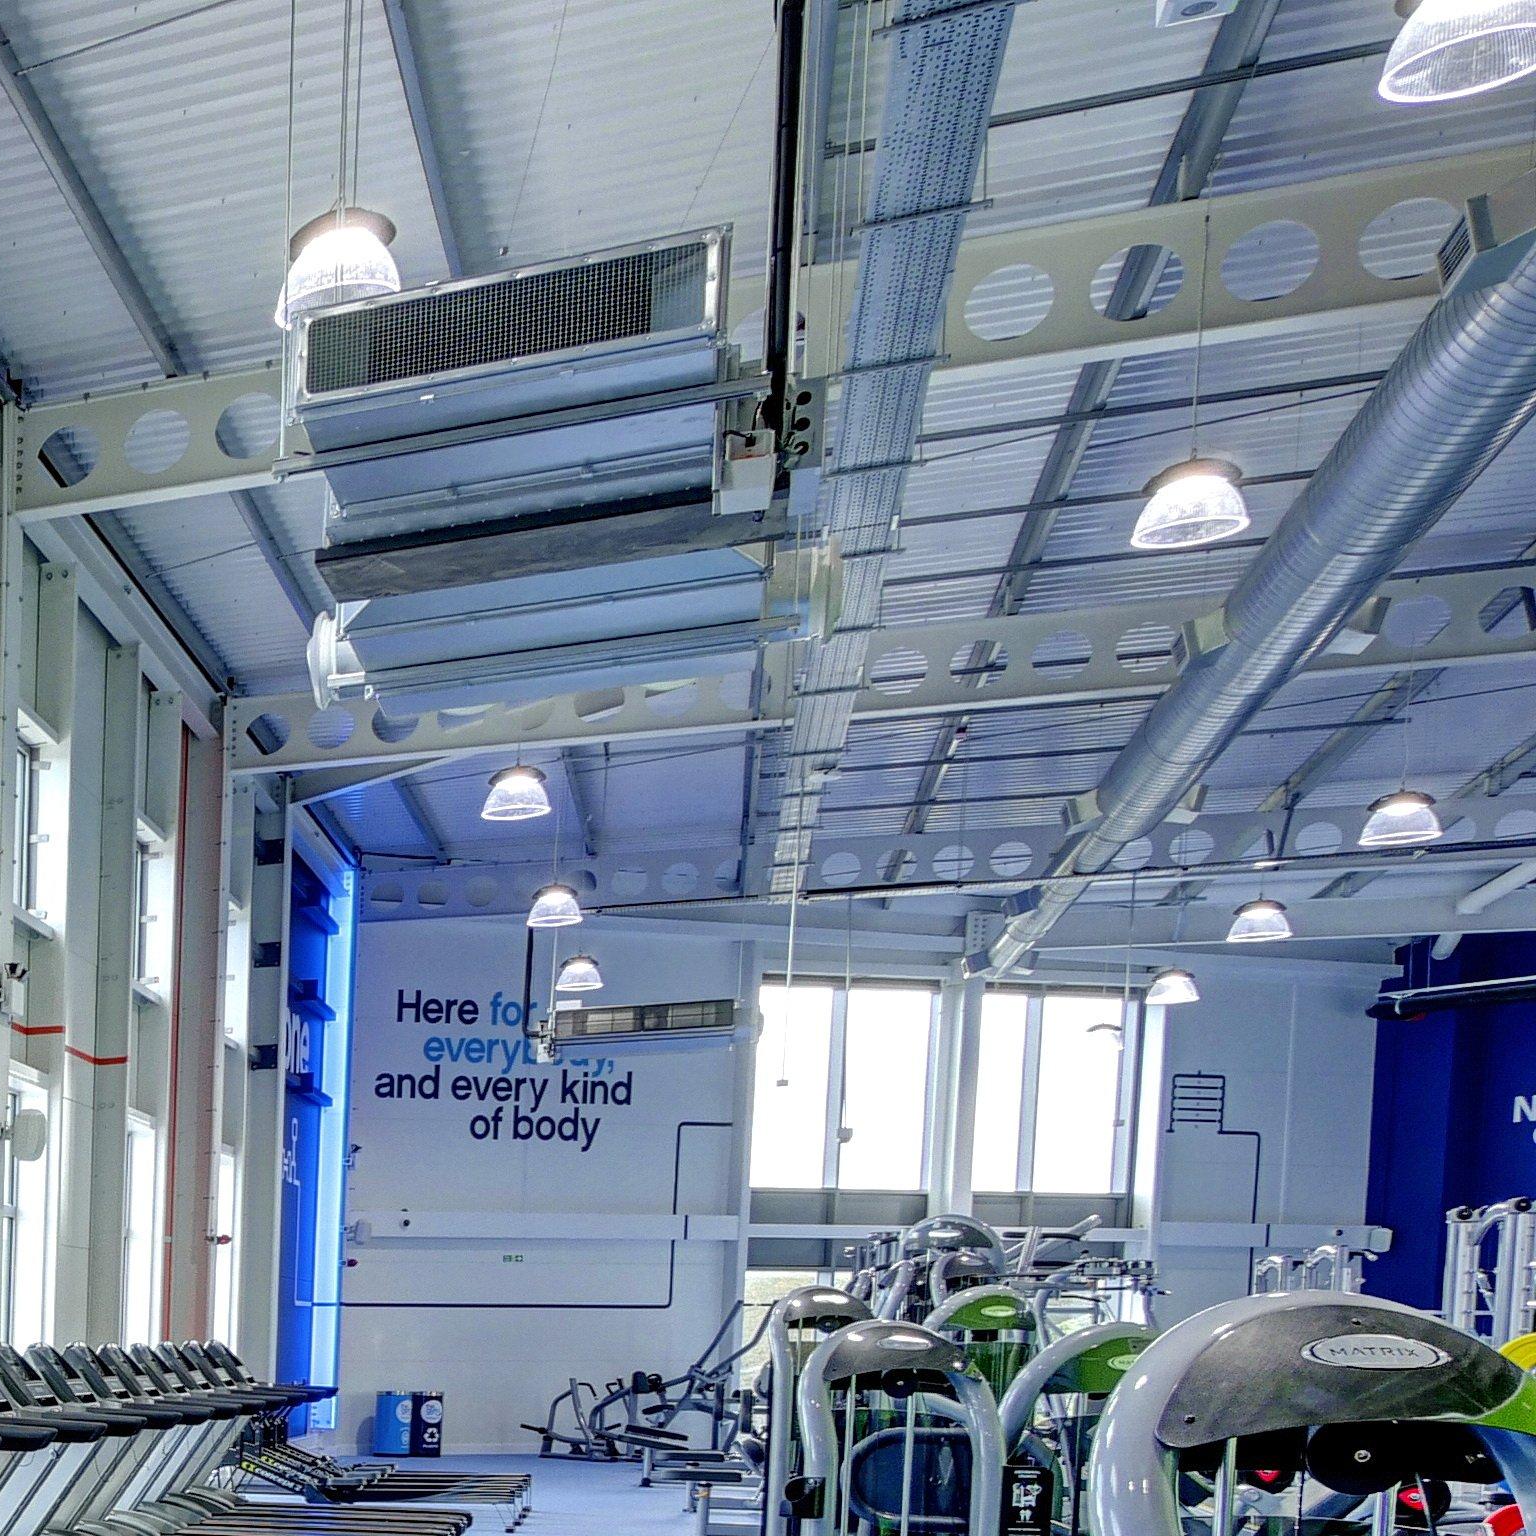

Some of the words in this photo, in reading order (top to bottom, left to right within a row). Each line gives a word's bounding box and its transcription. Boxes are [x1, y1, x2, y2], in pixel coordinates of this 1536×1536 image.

[396, 988, 479, 1025] Here
[374, 1064, 441, 1100] and
[450, 1074, 549, 1113] every
[560, 1068, 634, 1106] kind
[469, 1105, 504, 1140] of
[512, 1104, 601, 1153] body
[1328, 1345, 1420, 1358] MATRIX
